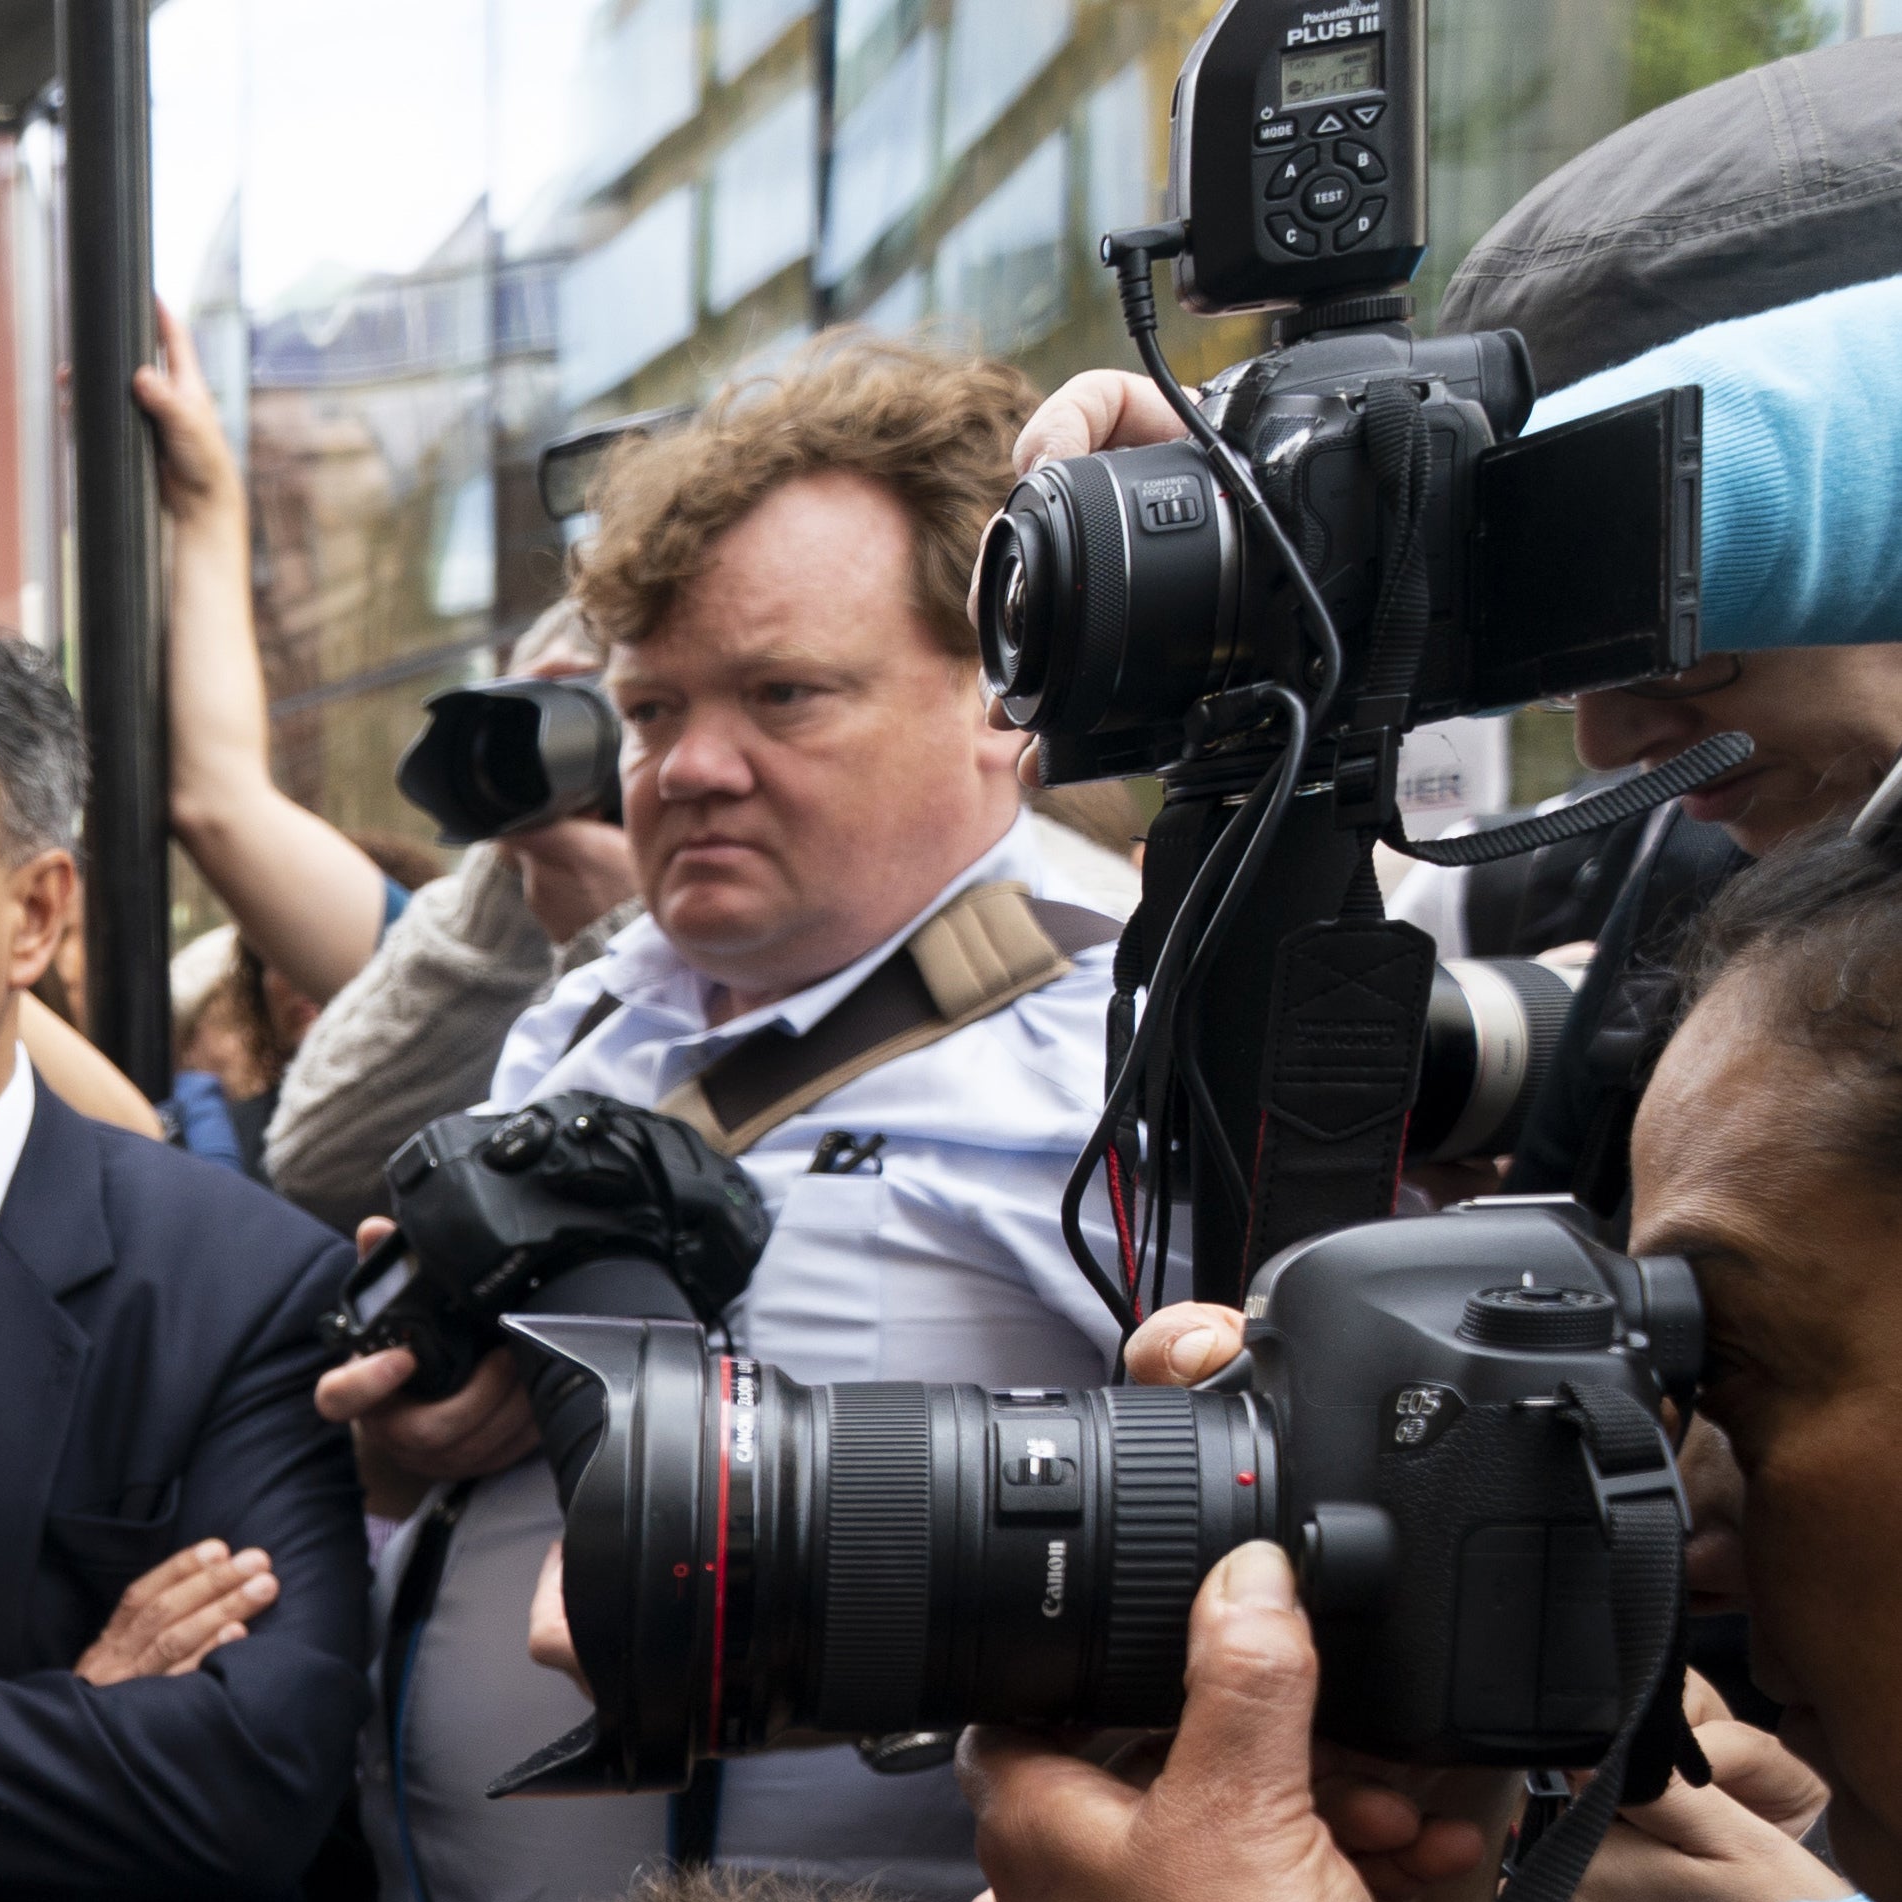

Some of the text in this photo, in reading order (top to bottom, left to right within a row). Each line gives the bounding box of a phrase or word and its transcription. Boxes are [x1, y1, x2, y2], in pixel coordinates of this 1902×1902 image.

[1286, 15, 1380, 46] PLUS III
[1260, 123, 1294, 140] MODE
[1357, 152, 1370, 168] B
[1284, 163, 1297, 178] A
[1313, 189, 1344, 205] TEST
[1357, 216, 1370, 232] D
[1285, 228, 1298, 244] C
[1143, 476, 1191, 489] CONTROL
[1142, 485, 1176, 497] FOCUS
[736, 1377, 755, 1406] ZOOM
[1396, 1390, 1443, 1415] EOS
[736, 1413, 754, 1463] CANON
[1041, 1540, 1067, 1618] Canon
